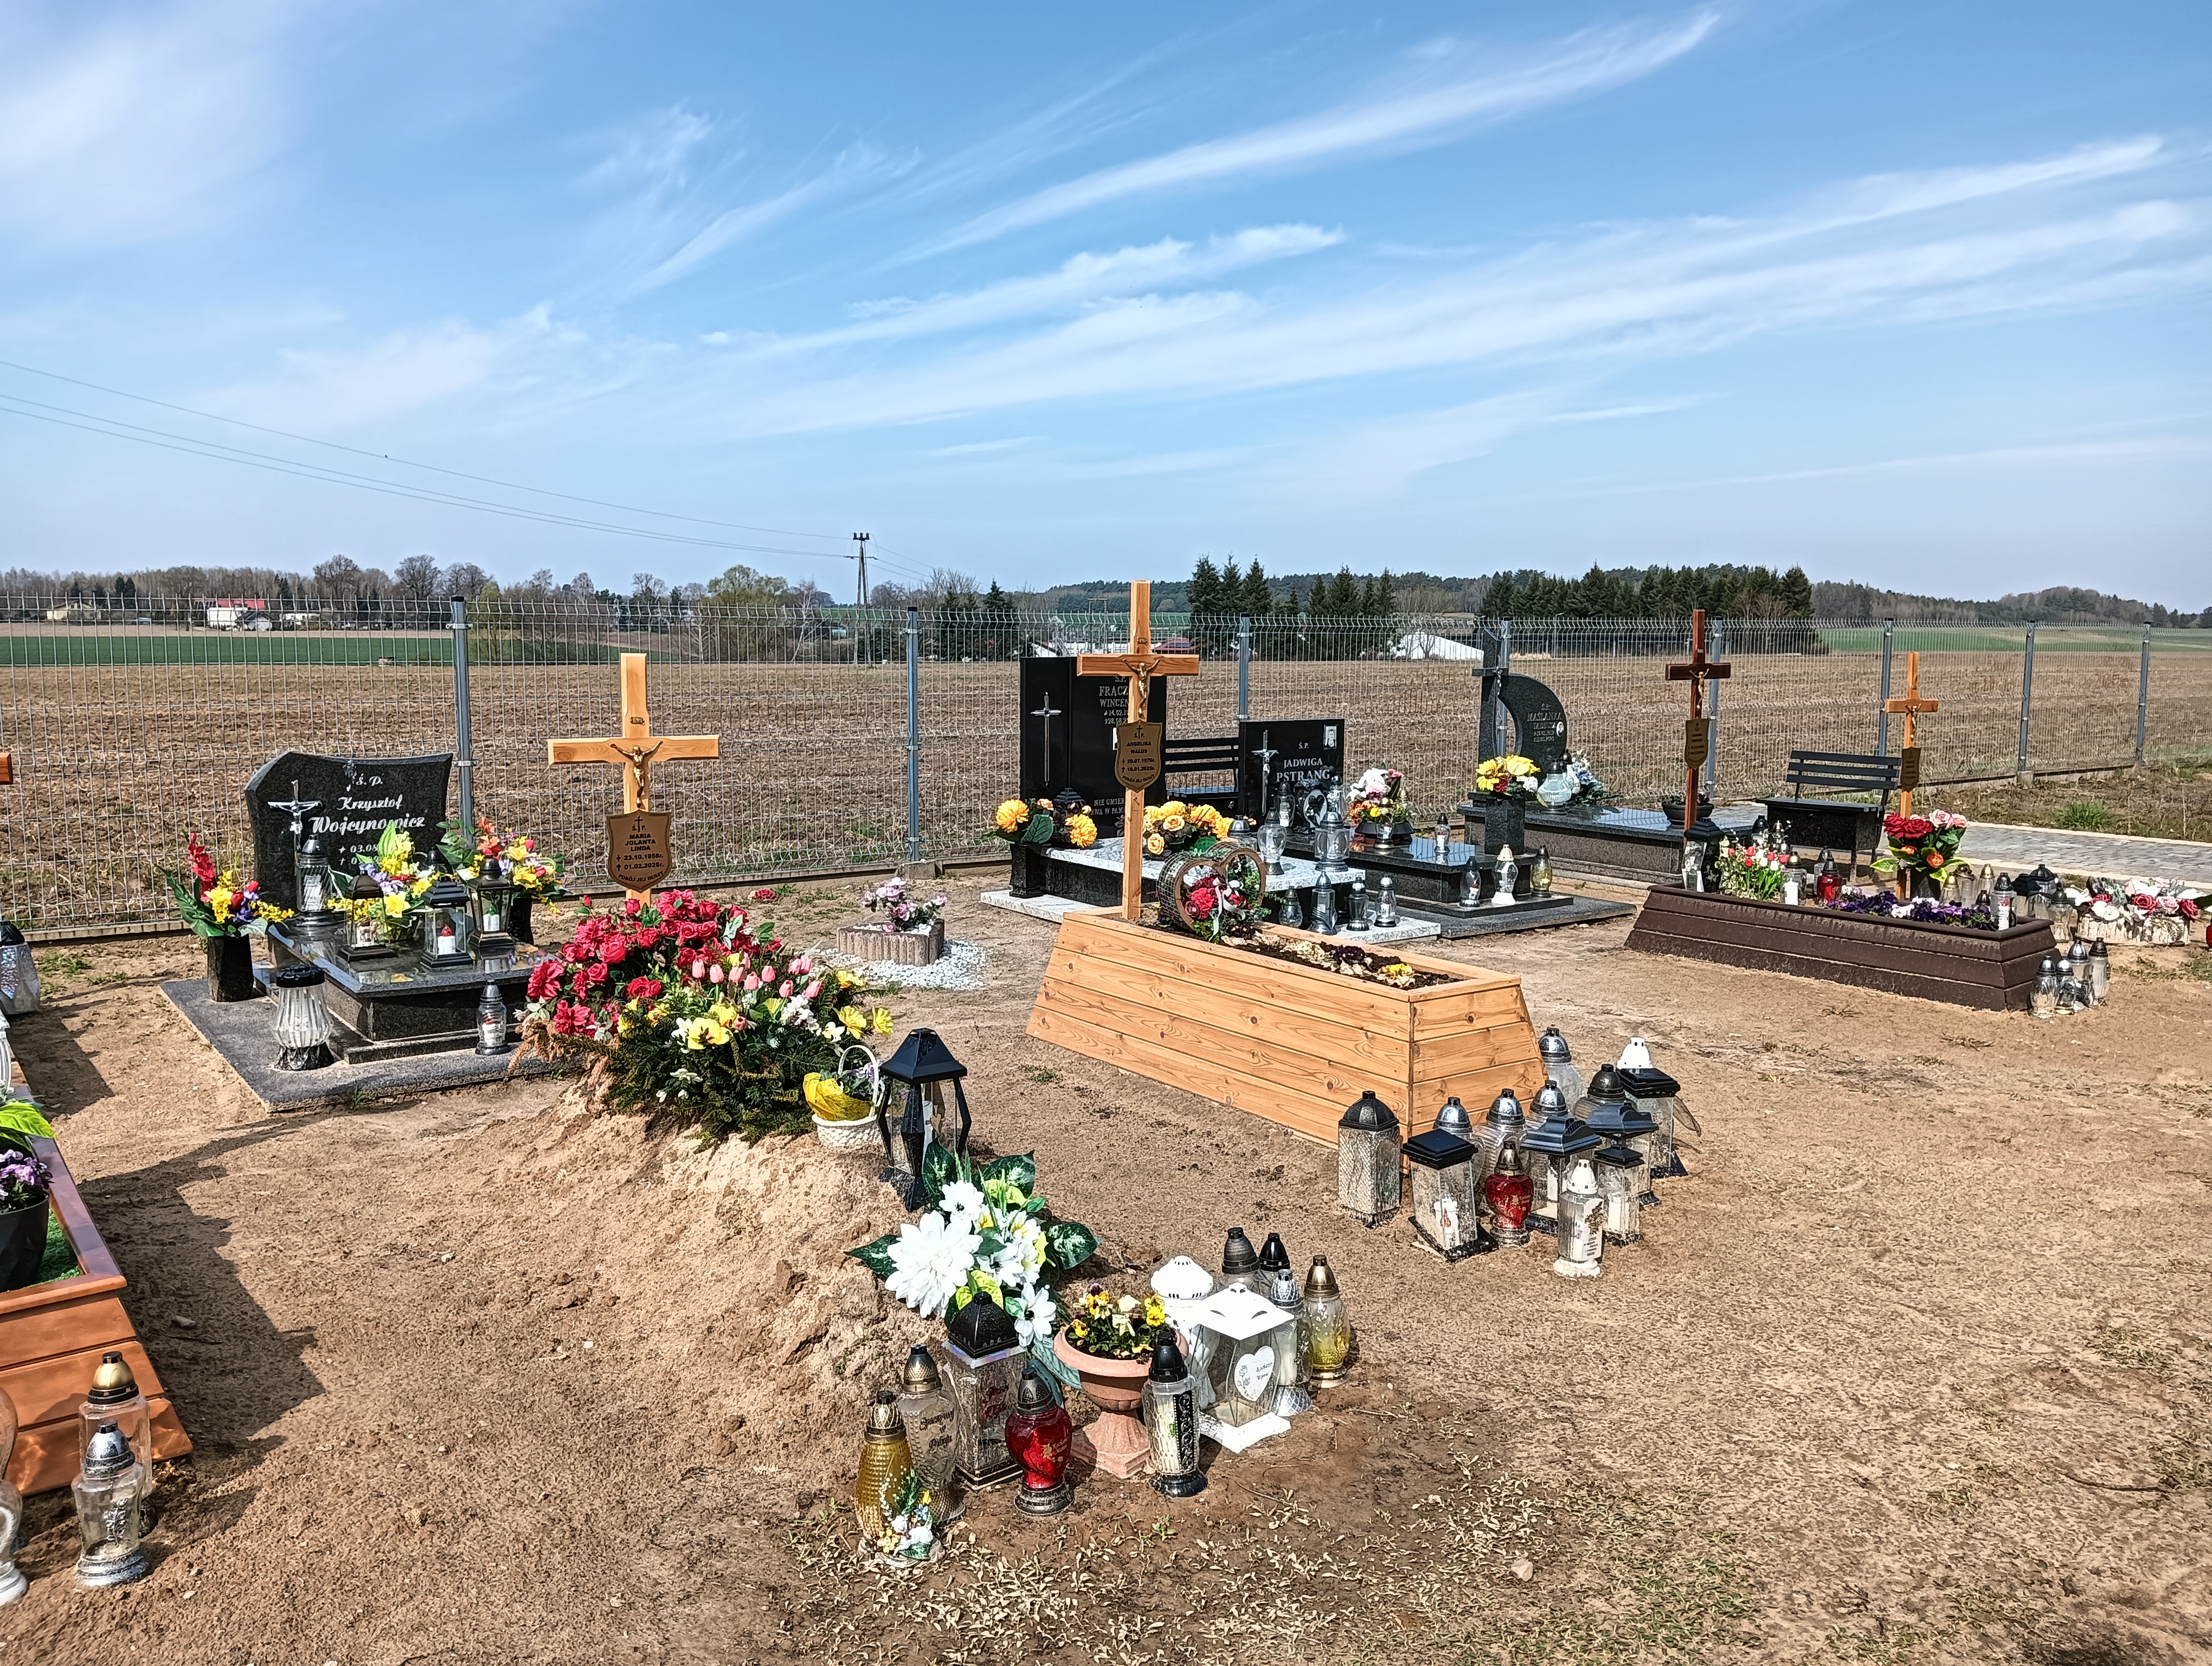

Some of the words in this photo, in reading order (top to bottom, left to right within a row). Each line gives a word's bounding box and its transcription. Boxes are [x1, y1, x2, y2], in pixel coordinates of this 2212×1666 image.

[1099, 699, 1129, 707] WINCEN
[1283, 757, 1323, 770] JADWIGA
[337, 794, 403, 811] Krzysztof
[618, 874, 636, 882] POKÓJ
[647, 870, 663, 881] DUSZY
